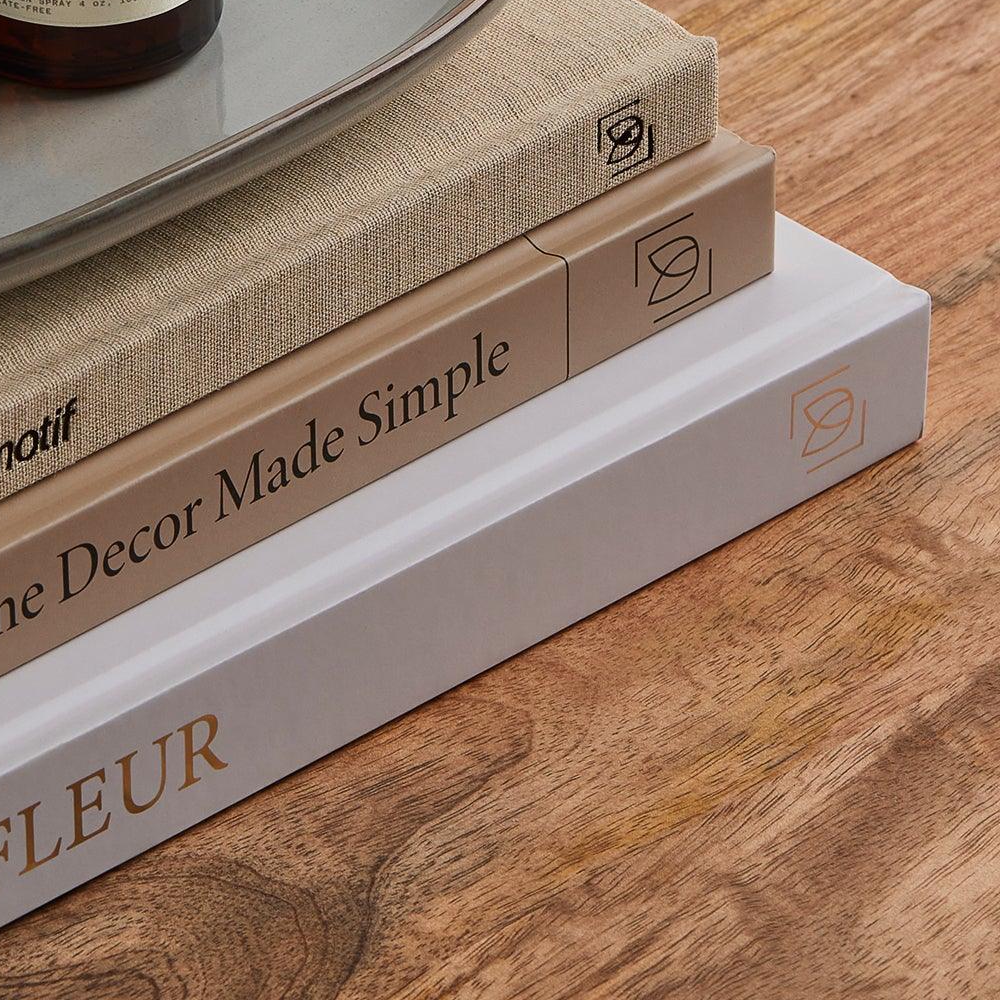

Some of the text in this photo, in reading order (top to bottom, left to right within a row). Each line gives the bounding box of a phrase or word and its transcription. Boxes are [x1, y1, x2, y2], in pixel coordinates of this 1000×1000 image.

[56, 497, 203, 604] Decor
[213, 417, 345, 523] Made
[357, 331, 510, 446] Simple
